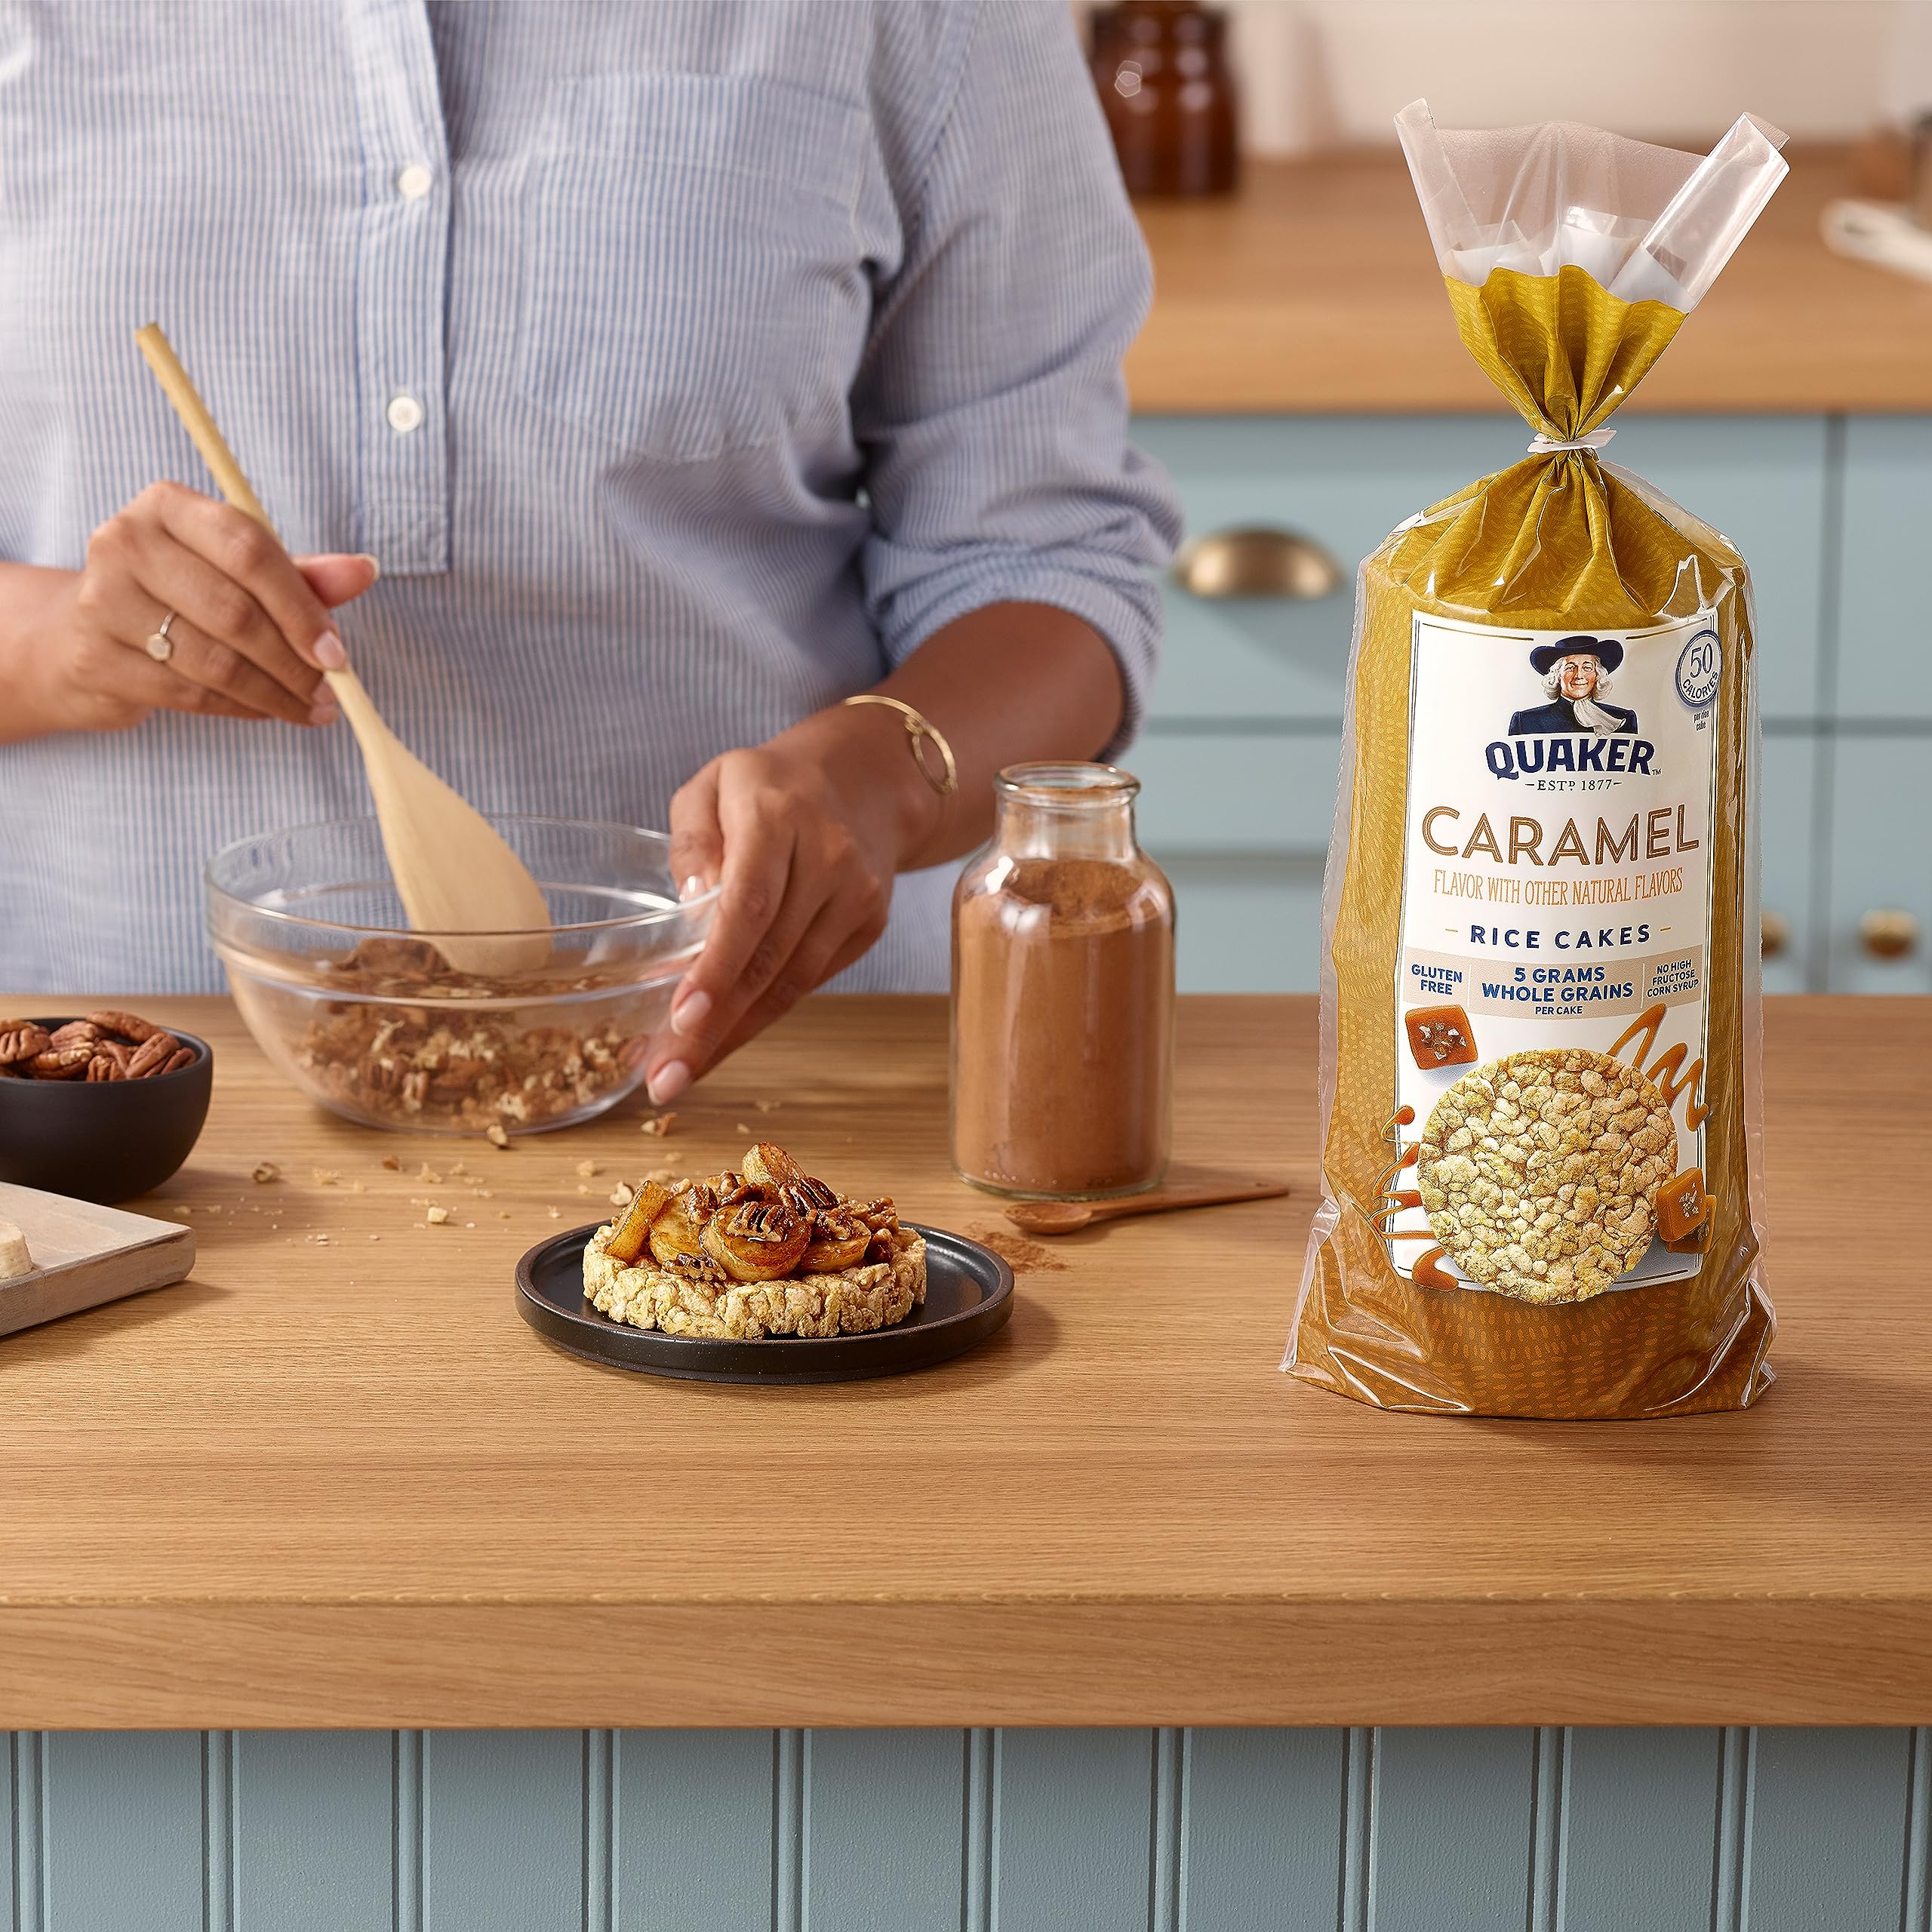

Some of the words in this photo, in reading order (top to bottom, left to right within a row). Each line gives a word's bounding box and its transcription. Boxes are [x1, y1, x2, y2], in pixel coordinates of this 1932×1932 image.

[1690, 642, 1713, 678] 50
[1682, 670, 1718, 699] CALORIES
[1696, 720, 1706, 731] cake
[1484, 738, 1655, 780] QUAKER
[1422, 804, 1700, 866] CARAMEL
[1433, 869, 1484, 900] FLAVOR
[1487, 877, 1520, 905] WITH
[1524, 880, 1568, 906] OTHER
[1573, 877, 1632, 906] NATURAL
[1634, 866, 1684, 900] FLAVORS
[1470, 924, 1540, 949] RICE
[1555, 924, 1651, 949] CAKES
[1411, 964, 1463, 983] GLUTEN
[1513, 967, 1525, 983] 5
[1532, 966, 1605, 983] GRAMS
[1657, 964, 1669, 974] NO
[1670, 958, 1692, 972] HIGH
[1420, 979, 1453, 995] FREE
[1652, 968, 1696, 986] FRUCTOSE
[1481, 983, 1555, 1002] WHOLE
[1561, 982, 1633, 1002] GRAINS
[1647, 985, 1671, 998] CORN
[1672, 978, 1699, 993] SYRUP
[1535, 1006, 1555, 1015] PER
[1556, 1005, 1583, 1015] CAKE
